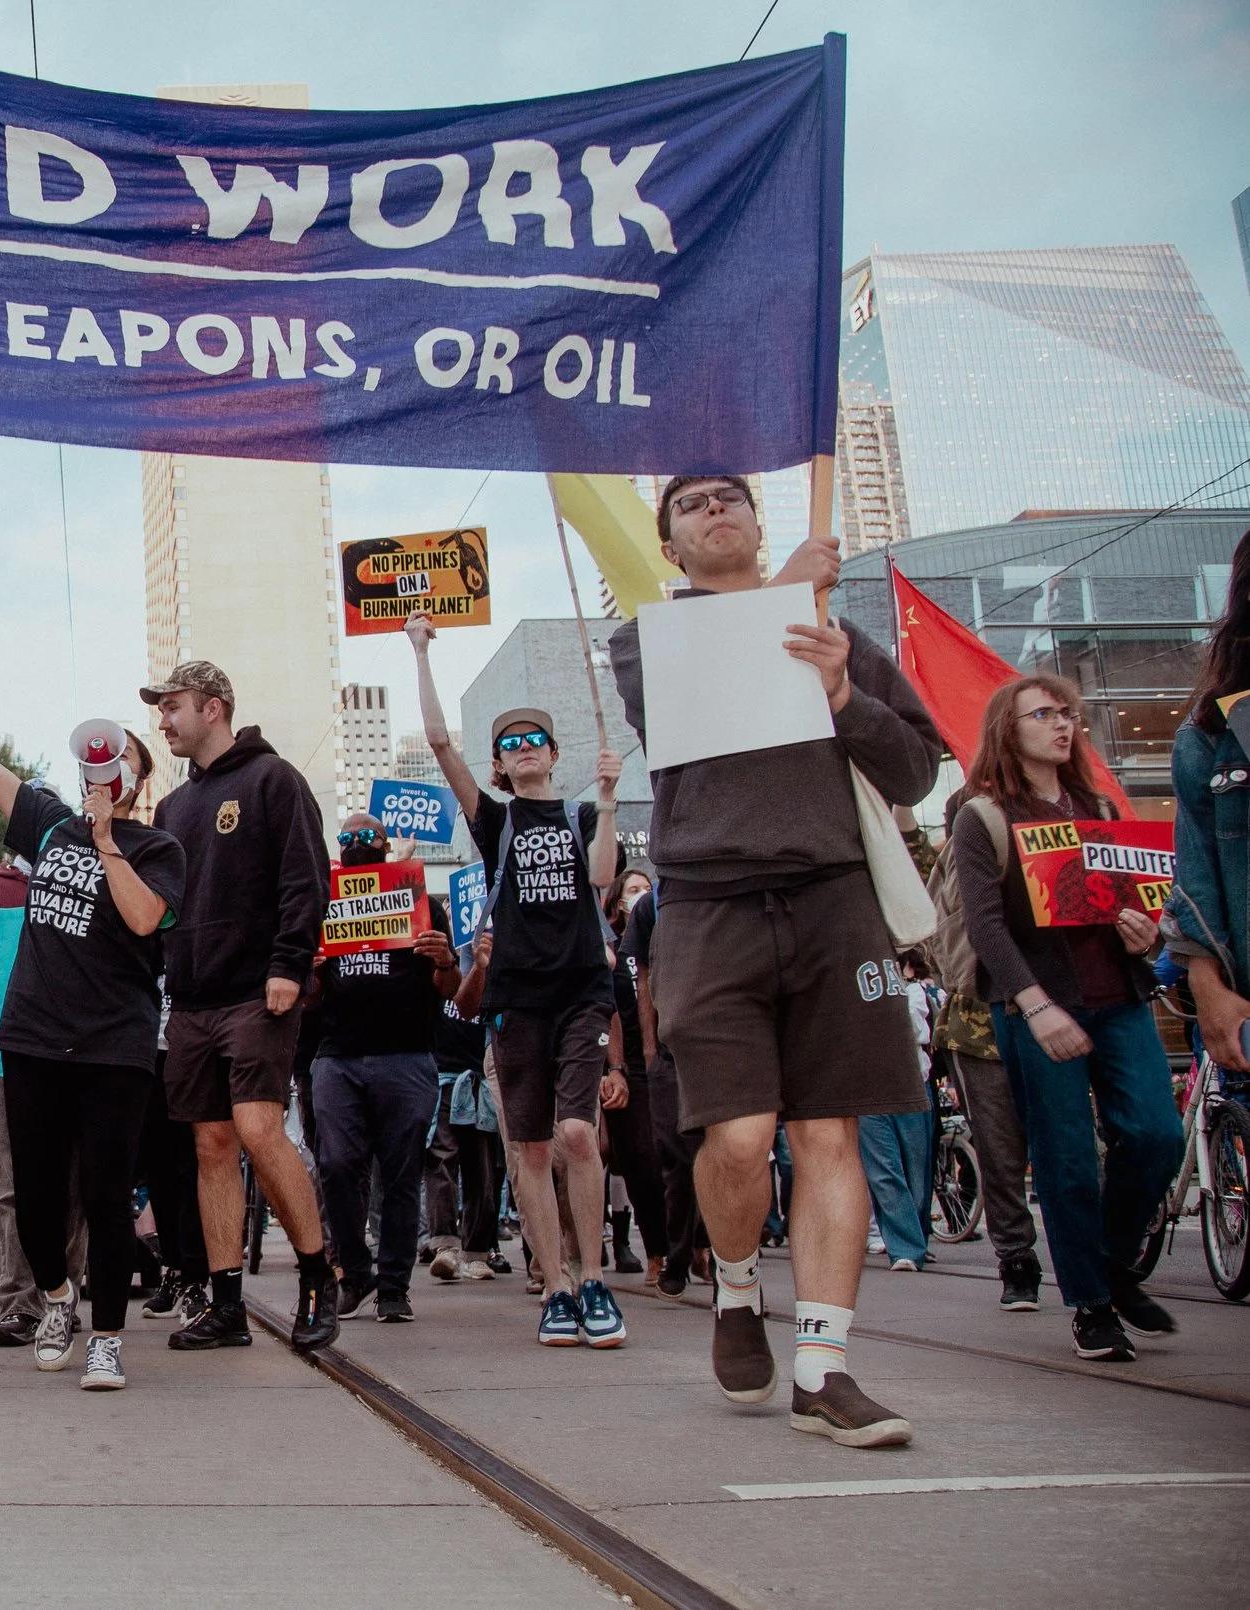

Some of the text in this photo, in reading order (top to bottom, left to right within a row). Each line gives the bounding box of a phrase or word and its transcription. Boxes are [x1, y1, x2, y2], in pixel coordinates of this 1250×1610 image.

[176, 139, 678, 255] WORK
[413, 326, 521, 394] OR
[544, 335, 651, 408] OIL
[371, 550, 459, 574] NO PIPELINES
[399, 573, 429, 593] ON A
[363, 596, 472, 618] BURNING PLANET
[400, 787, 428, 797] Invest in
[384, 794, 442, 815] GOOD
[381, 811, 439, 833] WORK
[524, 826, 548, 836] INVEST
[67, 843, 92, 855] INVEST
[513, 829, 574, 851] GOOD
[1021, 824, 1078, 852] MAKE
[46, 847, 106, 874] GOOD
[515, 844, 575, 868] WORK
[36, 861, 103, 895] WORK
[516, 871, 575, 888] LIVABLE
[536, 865, 551, 873] AND
[50, 883, 74, 896] AND A
[344, 876, 376, 896] STOP
[458, 872, 476, 889] OUR
[30, 889, 95, 920] LIVABLE
[326, 892, 411, 920] AST-TRACKING
[459, 890, 467, 904] IS
[518, 886, 577, 904] FUTURE
[29, 907, 90, 937] FUTURE
[326, 916, 409, 941] DESTRUCTION
[460, 900, 483, 935] SA
[339, 952, 391, 967] LIVABLE
[339, 963, 390, 978] FUTURE
